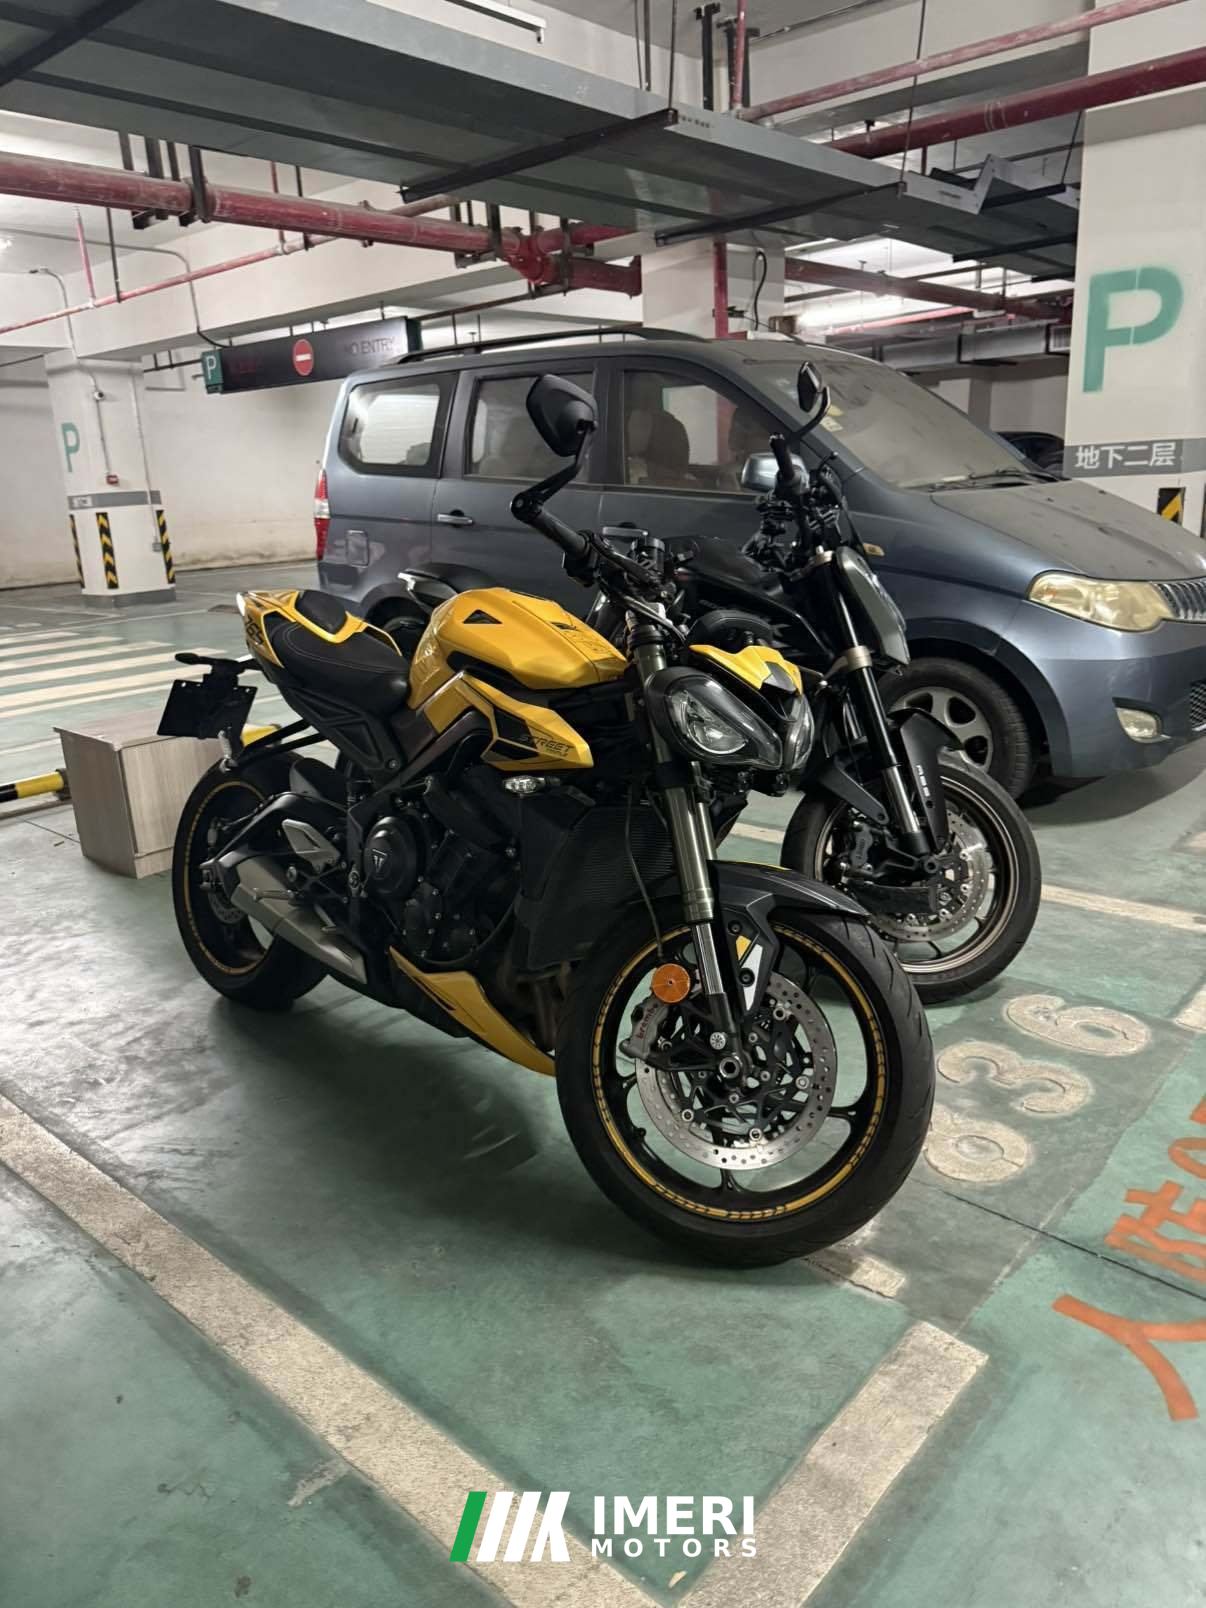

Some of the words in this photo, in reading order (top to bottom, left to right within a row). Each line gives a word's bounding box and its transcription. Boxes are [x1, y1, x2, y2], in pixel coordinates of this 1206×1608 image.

[1083, 267, 1184, 392] P
[360, 336, 395, 354] ENTRY
[205, 355, 217, 380] P
[61, 423, 80, 472] P
[1075, 442, 1176, 469] 地下二层
